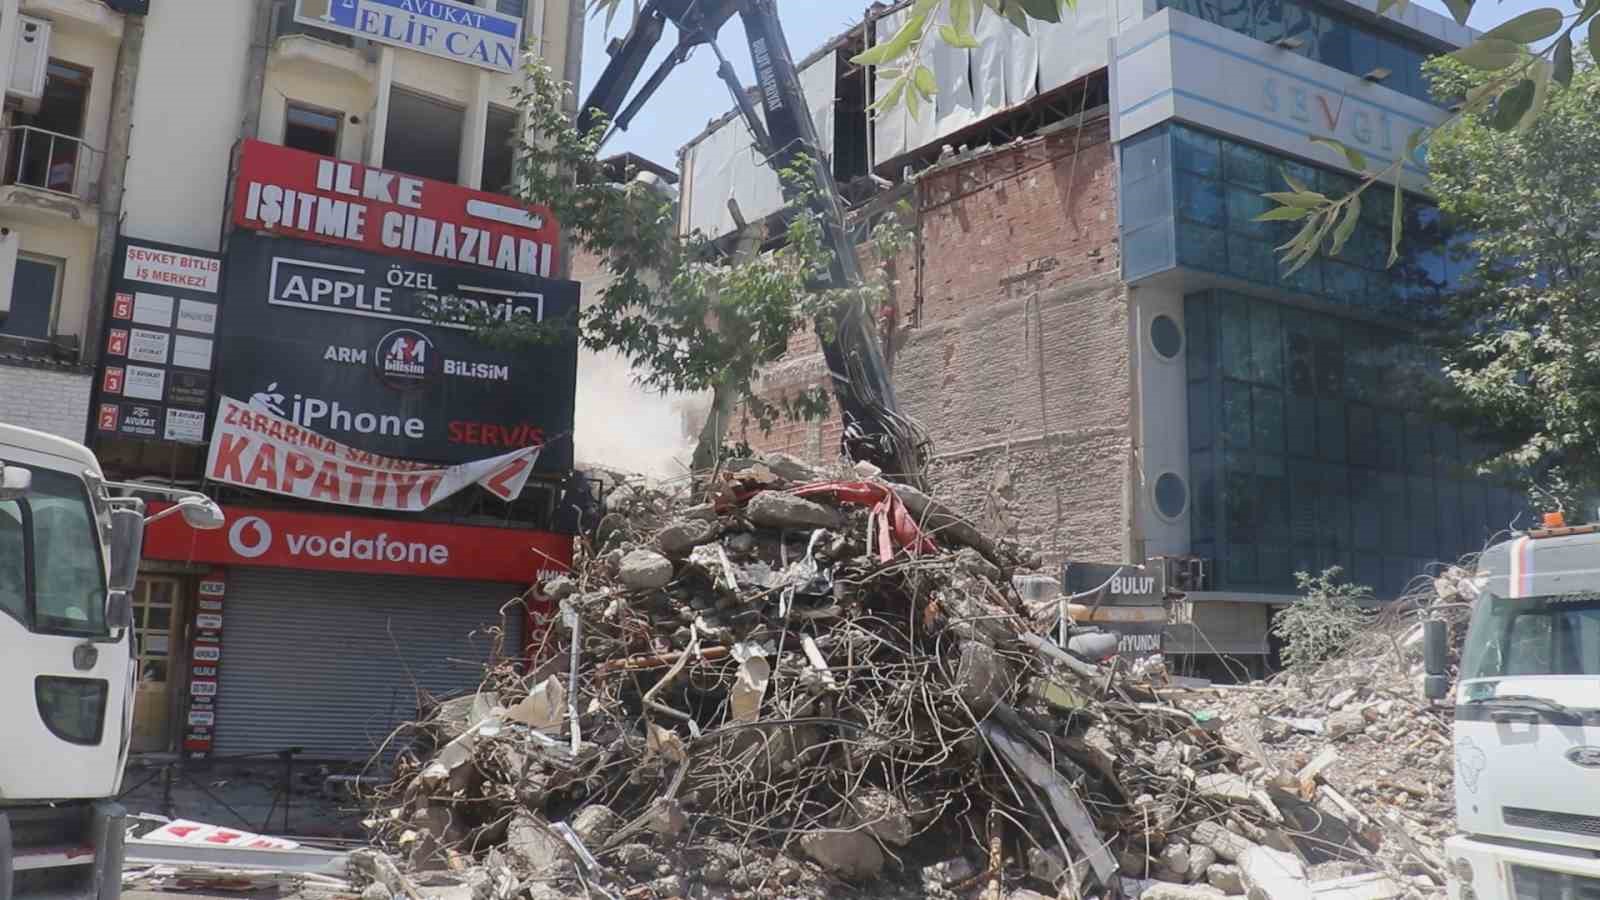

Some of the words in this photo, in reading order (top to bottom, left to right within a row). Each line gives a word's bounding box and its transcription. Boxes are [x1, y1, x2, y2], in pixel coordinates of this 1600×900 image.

[400, 0, 487, 29] AVUKAT
[360, 8, 438, 47] ELİF
[445, 31, 514, 68] CAN
[386, 263, 437, 290] ÖZEL
[281, 275, 393, 312] APPLE
[119, 305, 127, 316] 5
[111, 342, 121, 353] 4
[324, 345, 368, 365] ARM
[109, 378, 118, 391] 3
[103, 415, 114, 428] 2
[292, 393, 425, 439] iPhone
[286, 530, 449, 565] vodafone
[1110, 576, 1155, 594] BULUT
